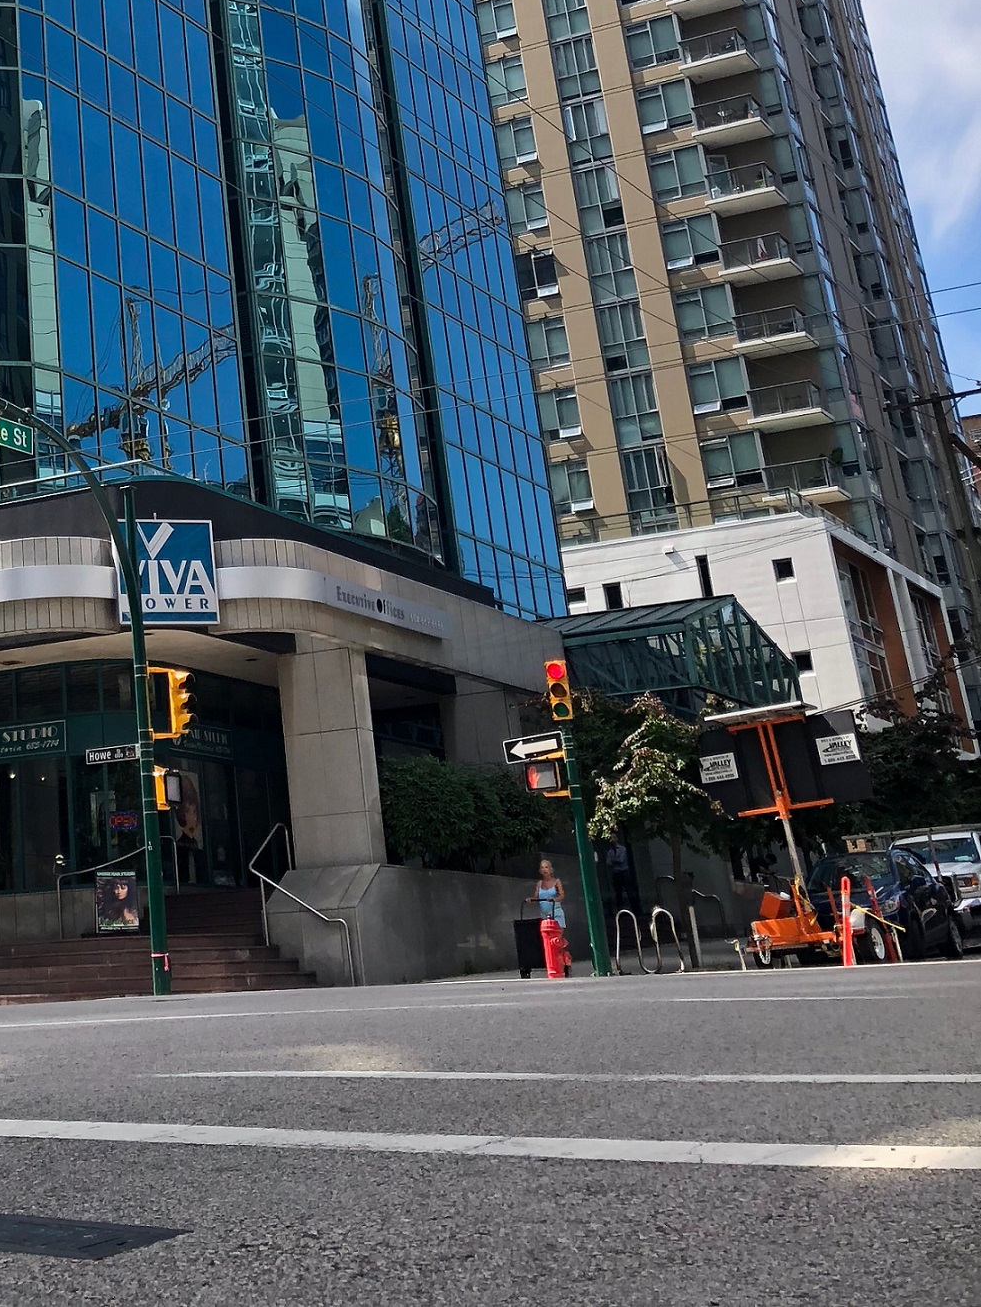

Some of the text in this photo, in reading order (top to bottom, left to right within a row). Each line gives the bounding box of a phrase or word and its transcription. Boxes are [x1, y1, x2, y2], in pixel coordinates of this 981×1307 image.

[13, 427, 27, 448] St
[145, 597, 209, 610] OWER
[2, 725, 58, 743] STUDIO
[89, 750, 112, 762] Howe
